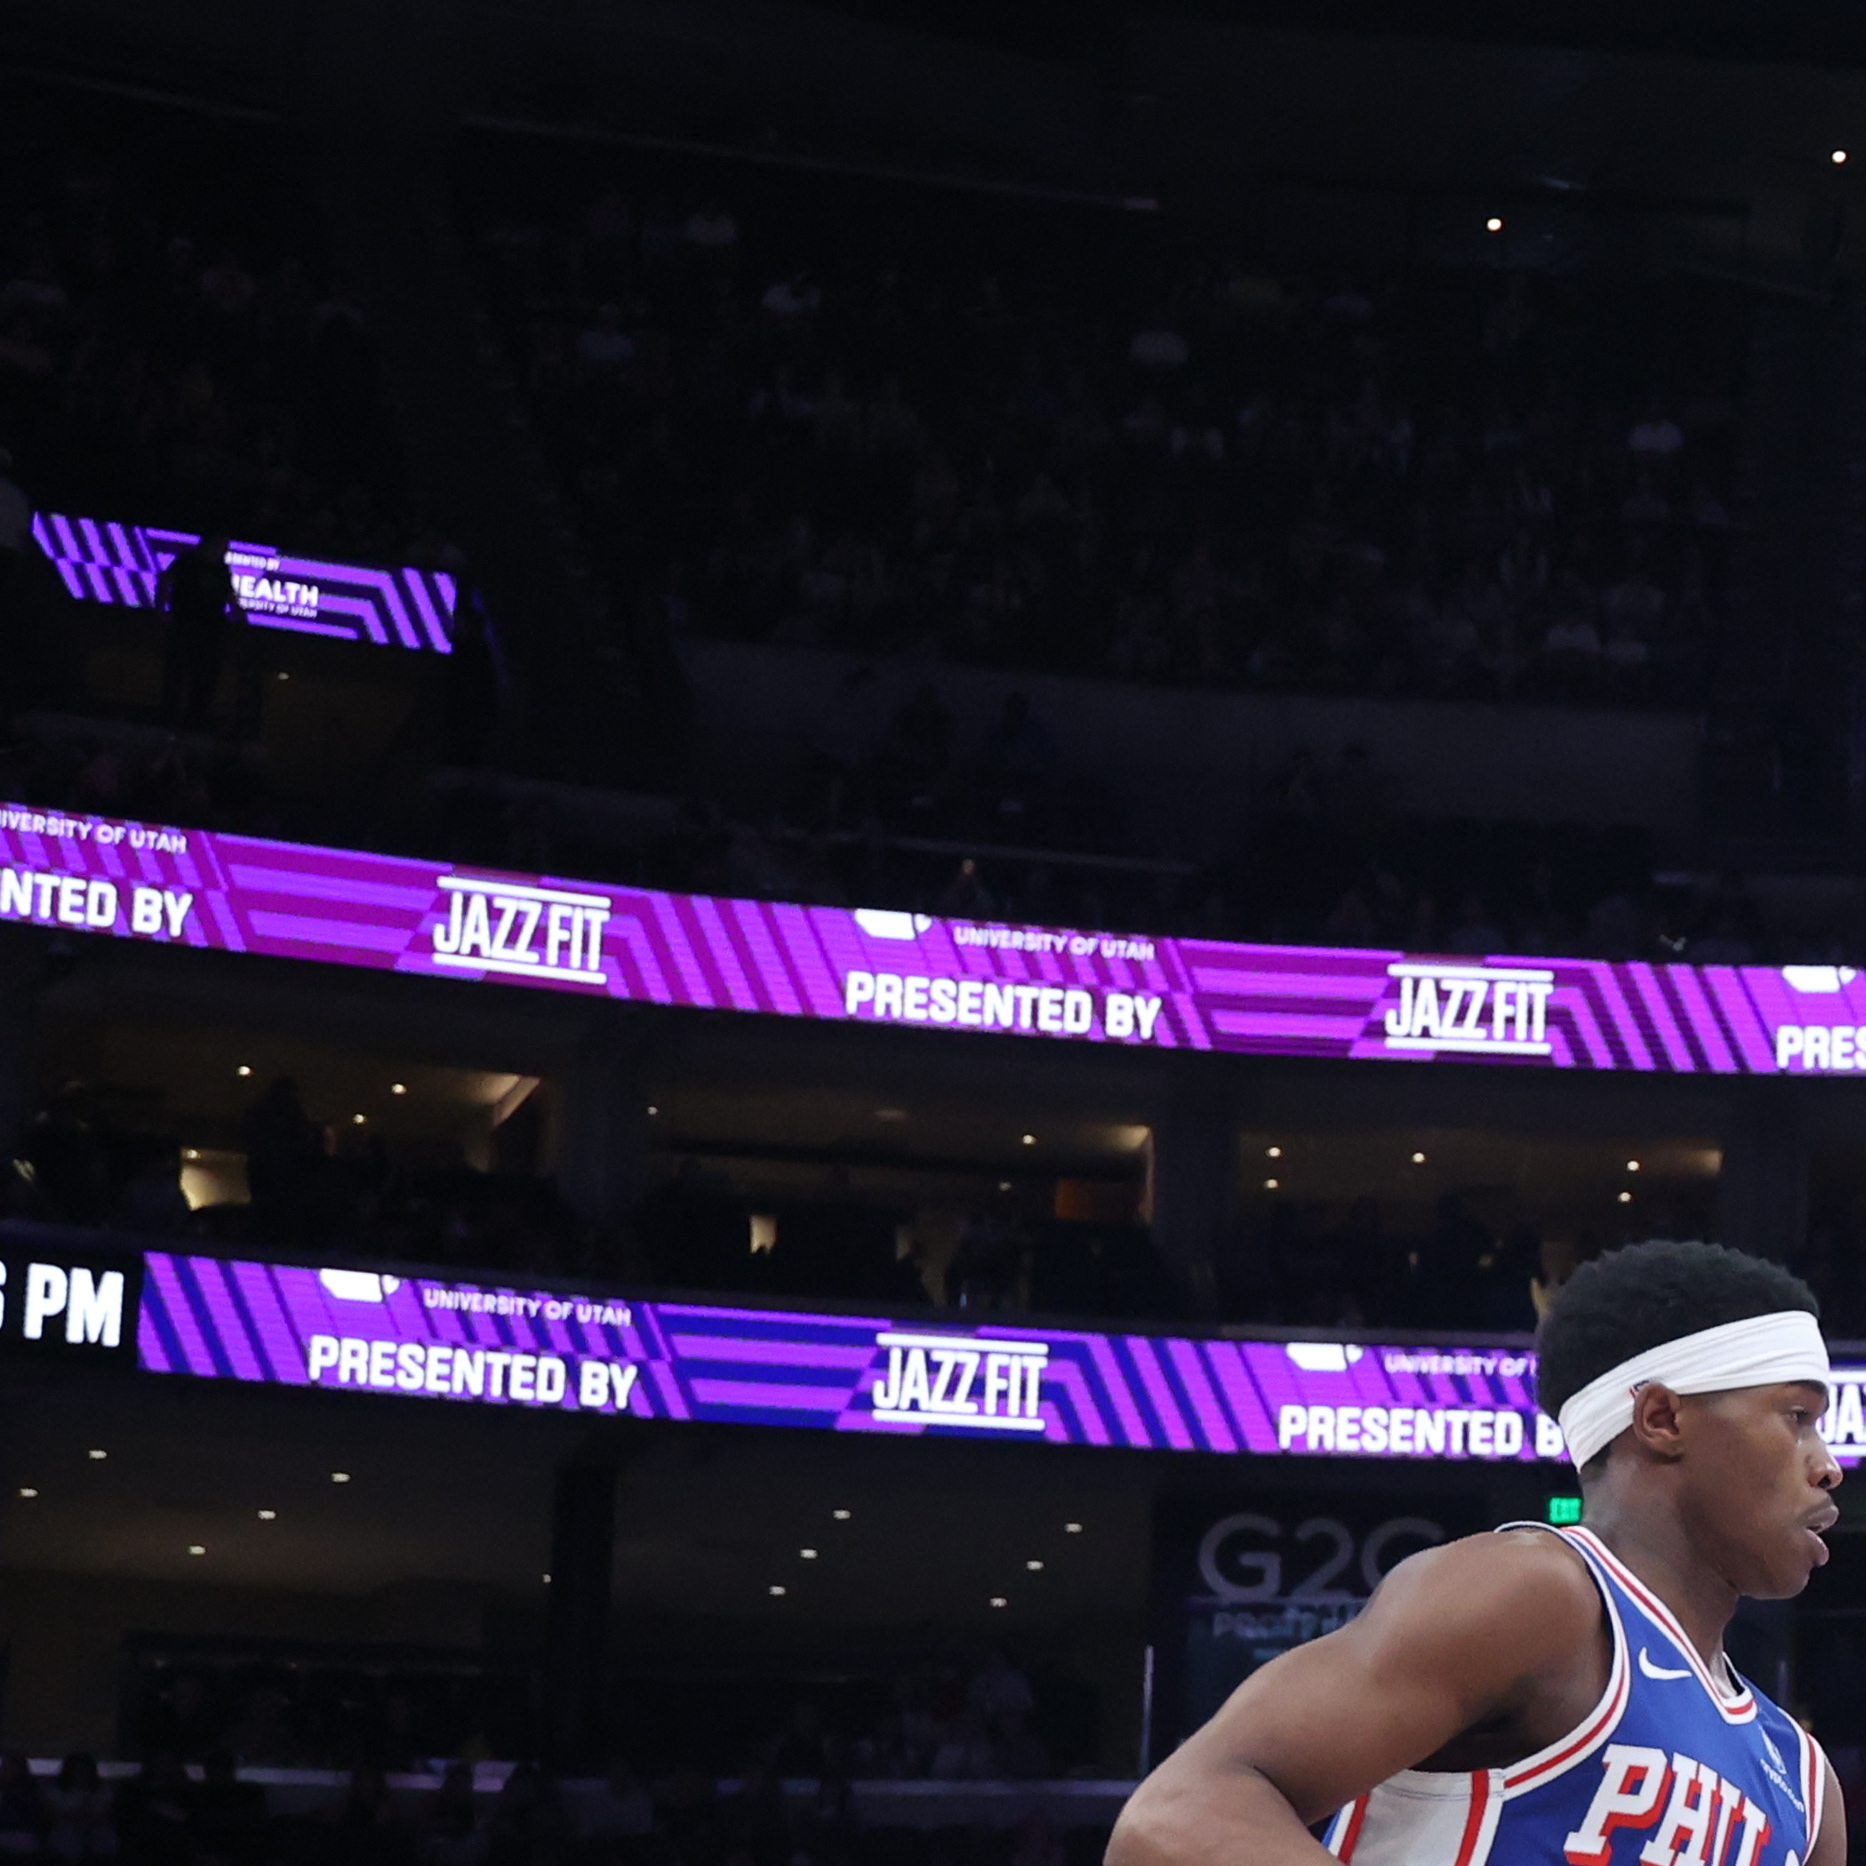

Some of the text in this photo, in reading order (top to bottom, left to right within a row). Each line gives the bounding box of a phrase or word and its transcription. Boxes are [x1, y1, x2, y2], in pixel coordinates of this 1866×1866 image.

[96, 822, 125, 846] OF
[130, 828, 188, 855] UTAH
[131, 888, 194, 939] BY
[432, 890, 611, 972] JAZZ FIT
[953, 924, 1156, 962] UNIVERSITY OF UTAH
[845, 970, 1163, 1042] PRESENTED BY
[1385, 974, 1552, 1044] JAZZ FIT
[23, 1262, 124, 1348] PM
[424, 1287, 632, 1327] UNIVERSITY OF UTAH
[308, 1334, 638, 1411] PRESENTED BY
[872, 1344, 1048, 1418] JAZZ FIT
[1384, 1351, 1496, 1377] UNIVERSITY
[1497, 1356, 1528, 1378] OF
[1278, 1403, 1565, 1458] PRESENTED B
